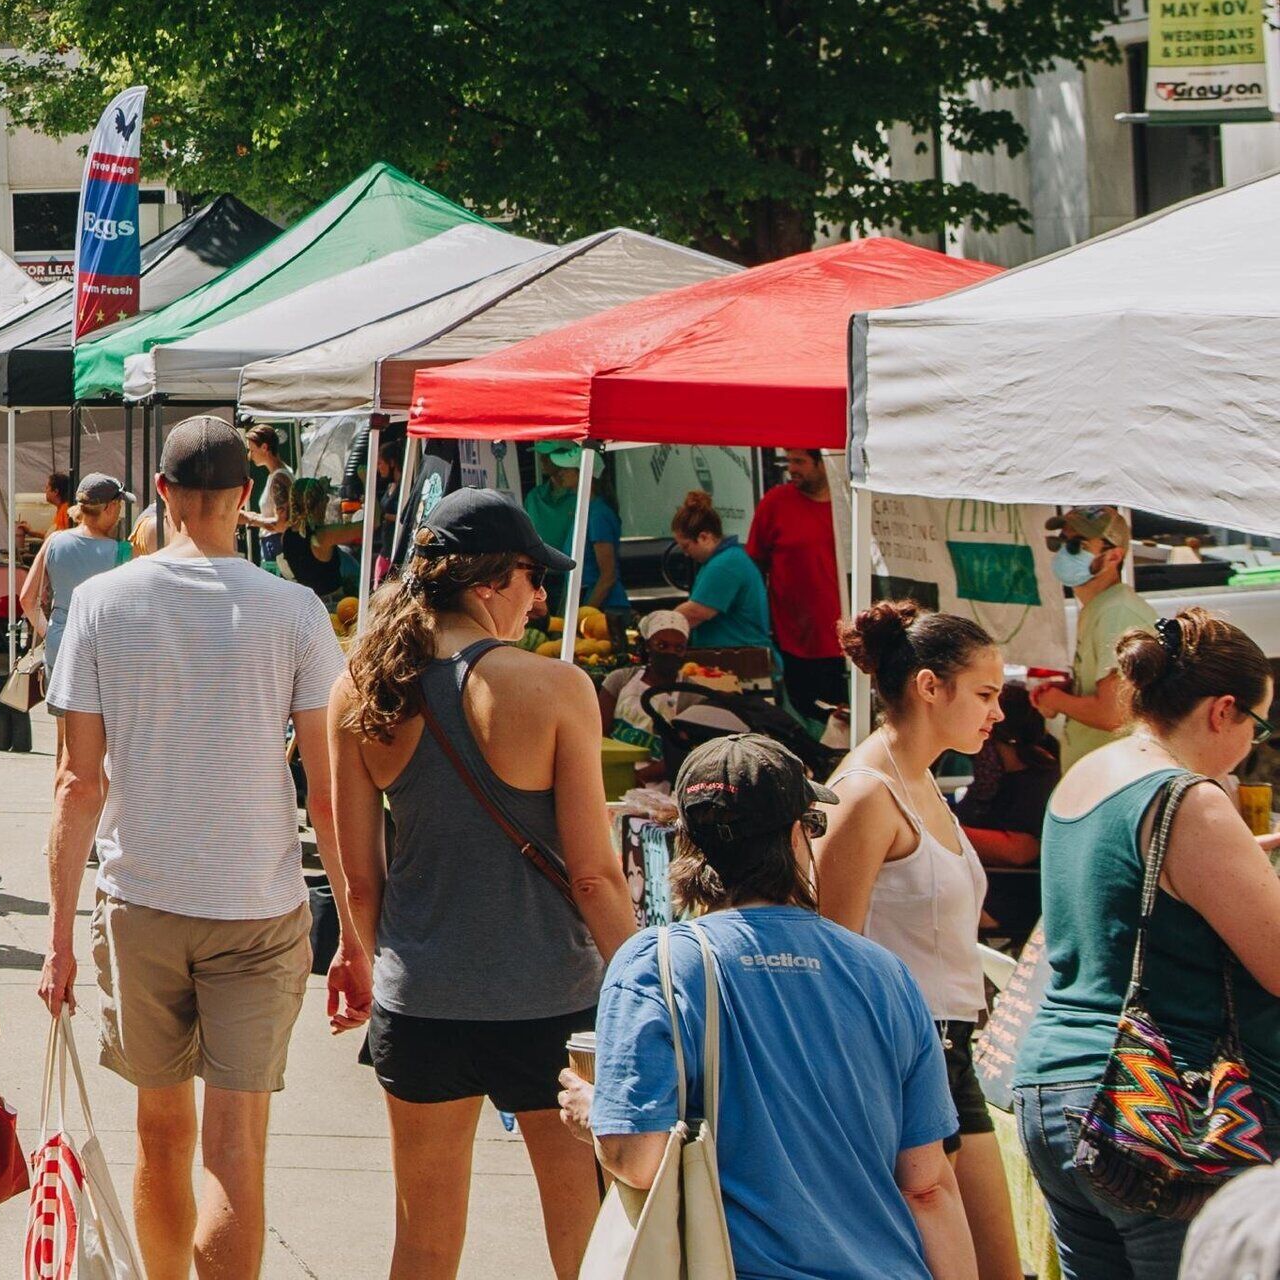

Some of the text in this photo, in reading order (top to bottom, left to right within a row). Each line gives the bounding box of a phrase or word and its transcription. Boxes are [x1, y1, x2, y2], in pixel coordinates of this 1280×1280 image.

[1160, 28, 1255, 42] WEDNESDAYS
[1162, 43, 1255, 58] & SATURDAYS
[1174, 82, 1261, 100] Grayson
[91, 160, 111, 173] Free
[83, 211, 135, 241] Eggs
[100, 284, 133, 295] Fresh
